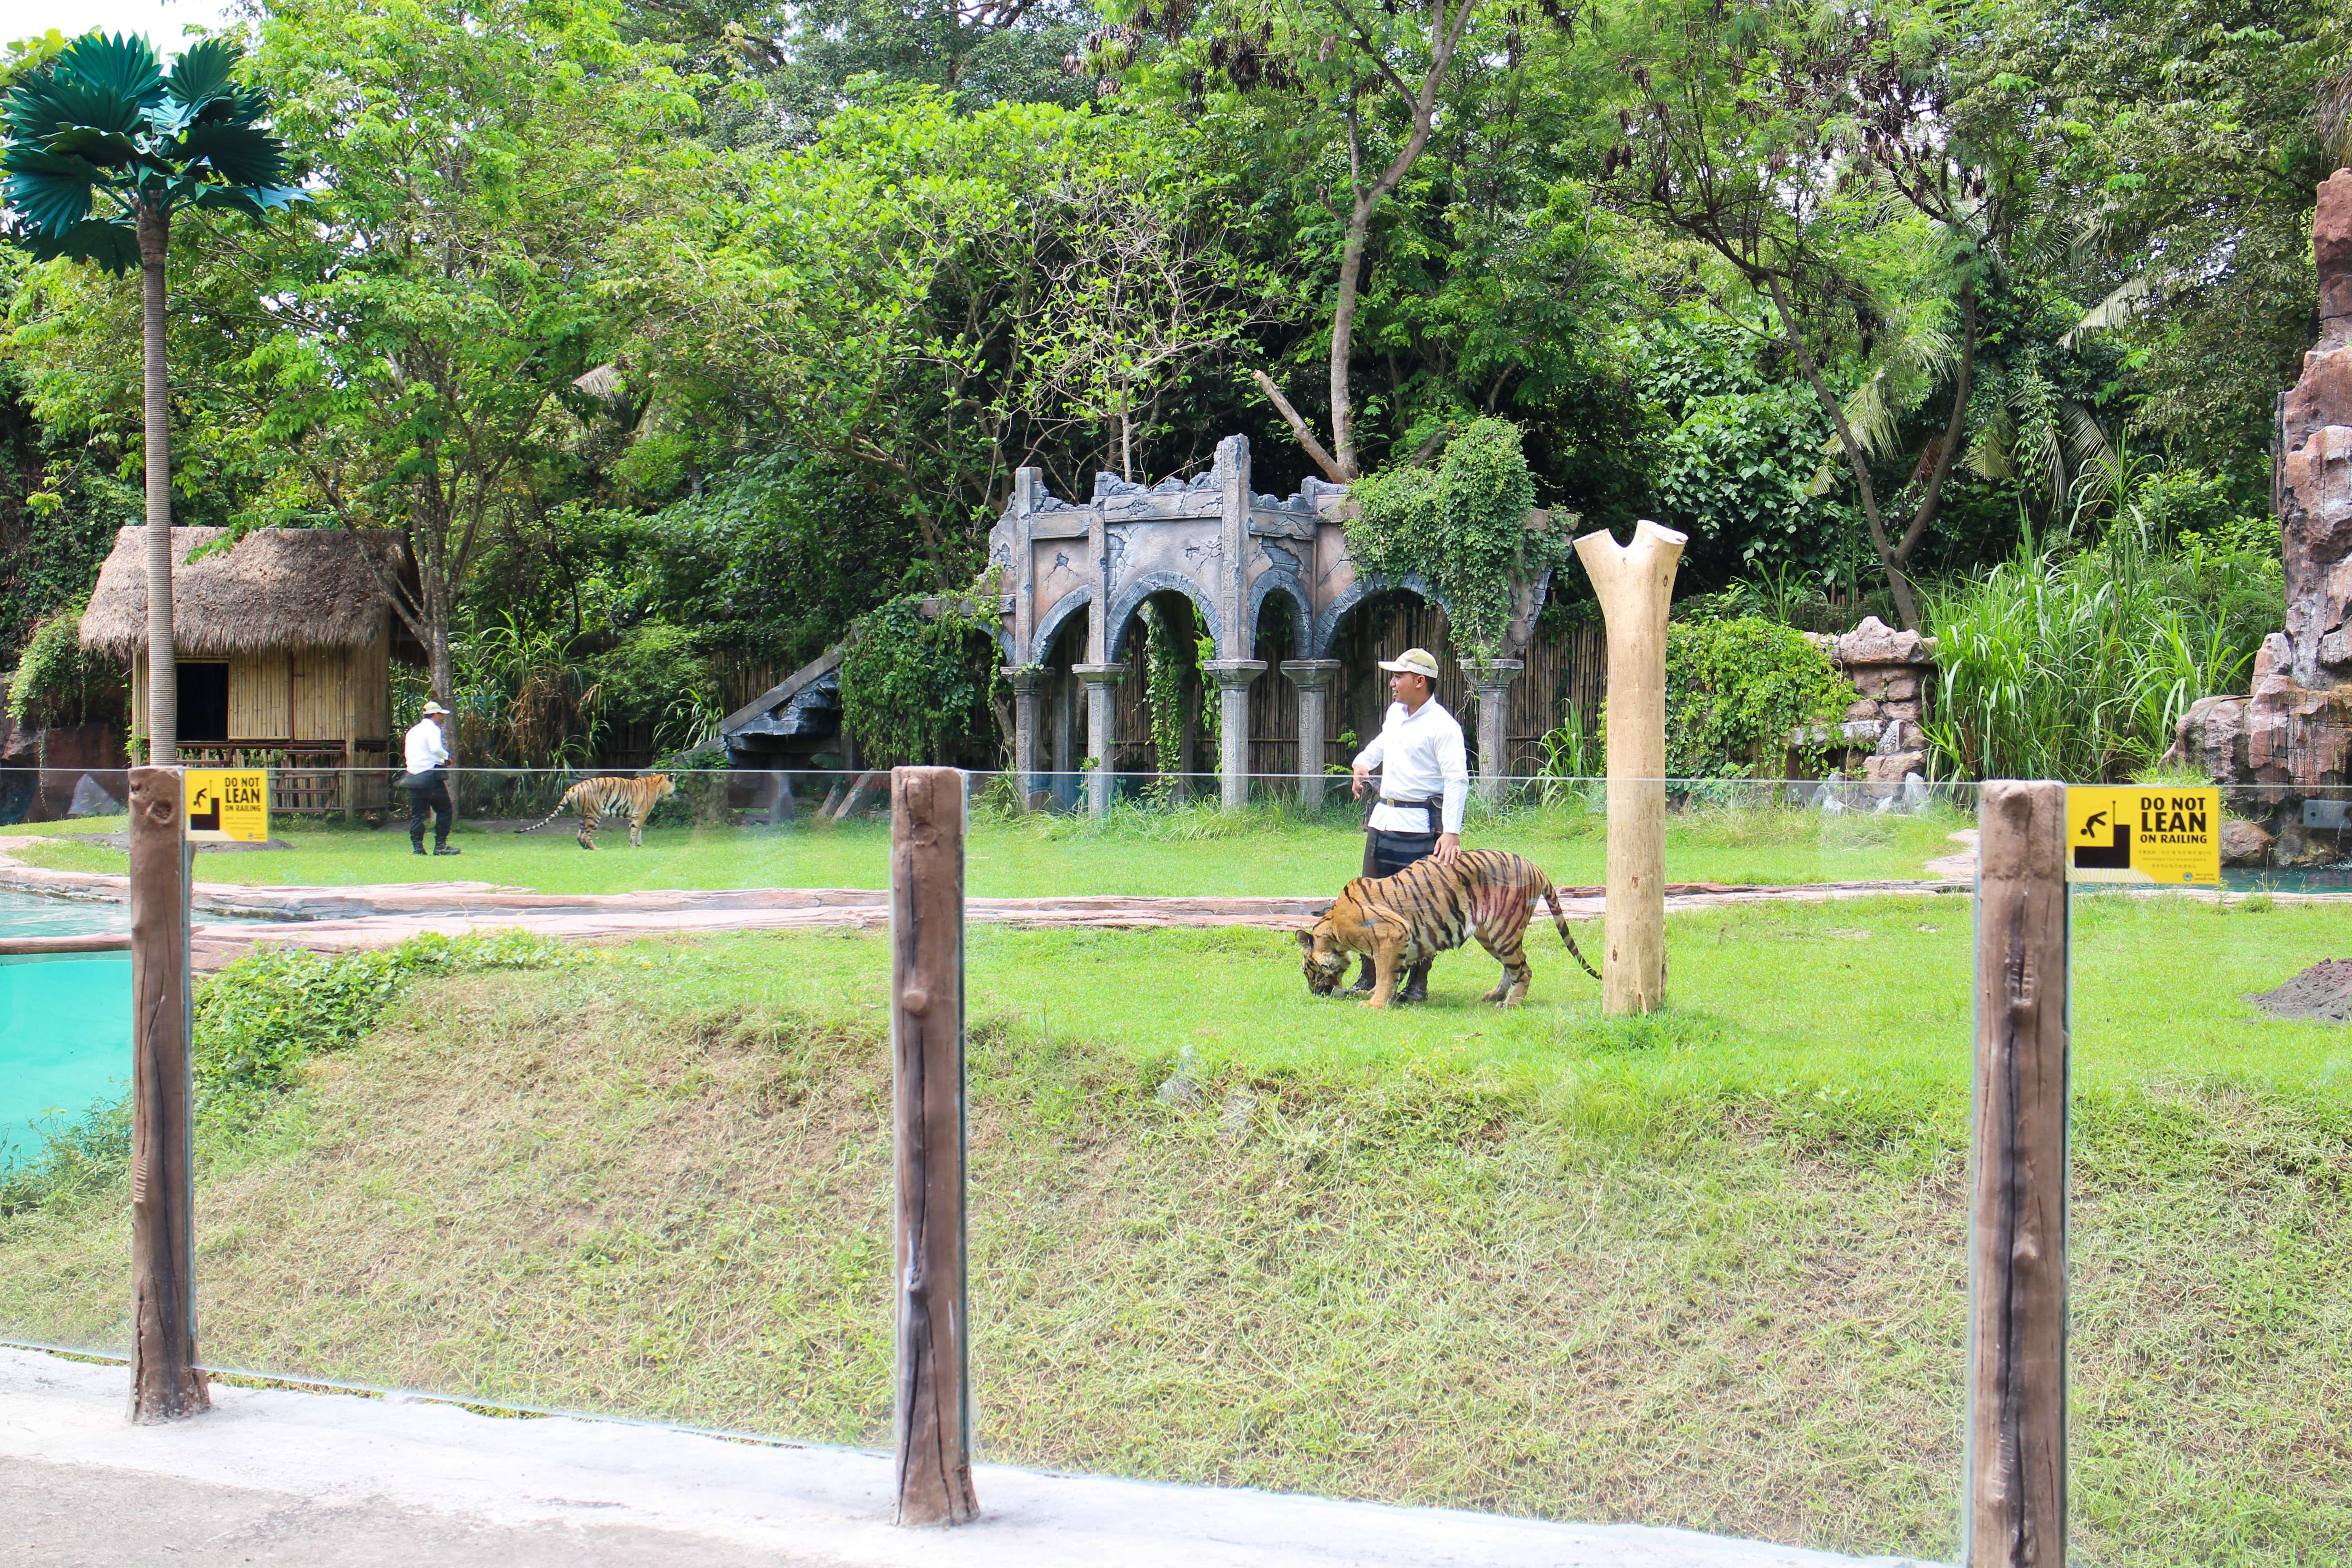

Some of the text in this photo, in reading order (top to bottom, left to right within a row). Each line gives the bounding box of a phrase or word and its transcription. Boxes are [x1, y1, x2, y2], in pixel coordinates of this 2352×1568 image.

[225, 777, 259, 787] DO NOT
[225, 788, 260, 804] LEAN
[2141, 797, 2205, 810] DO NOT
[2141, 812, 2206, 833] LEAN
[2140, 834, 2207, 844] ON RAILING
